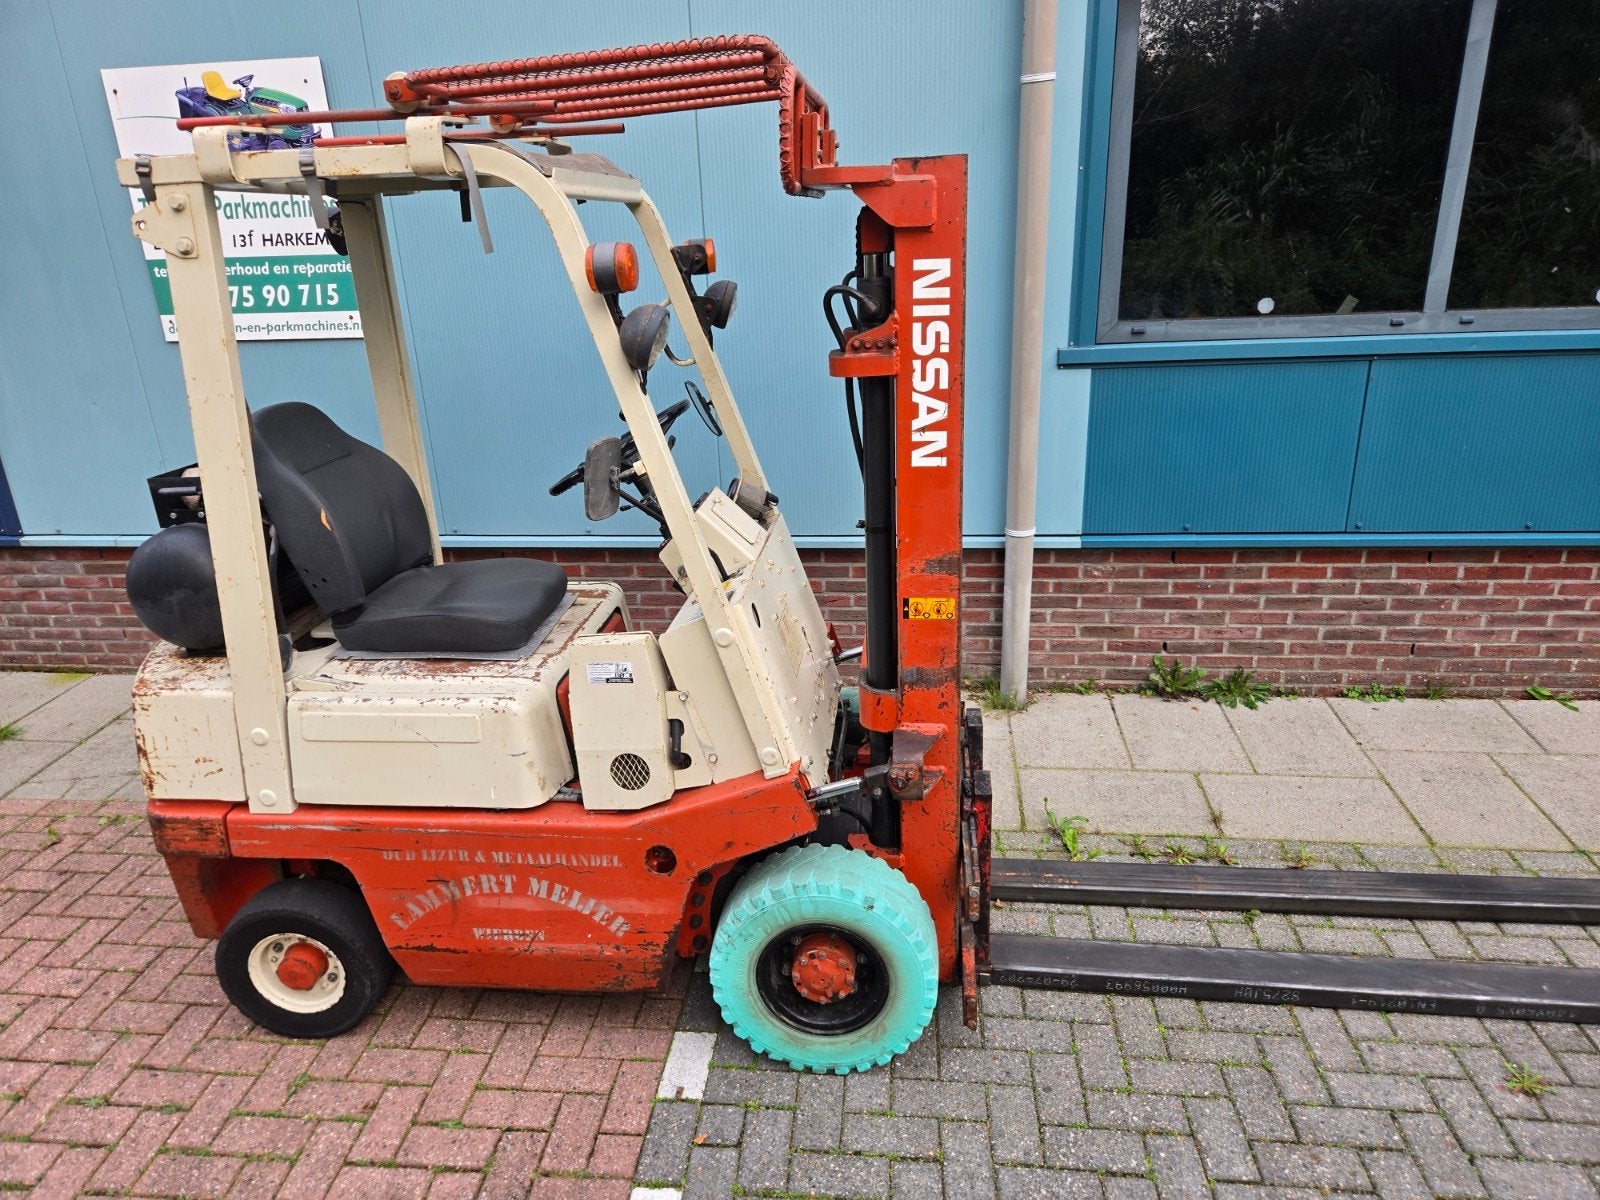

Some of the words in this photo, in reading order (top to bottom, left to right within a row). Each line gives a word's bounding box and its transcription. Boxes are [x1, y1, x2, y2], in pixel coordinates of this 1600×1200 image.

[262, 231, 331, 247] HARKEM
[225, 262, 269, 275] erhoud
[273, 264, 289, 274] en
[262, 285, 290, 307] 90
[298, 283, 339, 306] 715
[911, 258, 951, 467] NISSAN
[475, 851, 486, 862] &
[491, 852, 622, 867] METAALHANDEL
[390, 874, 516, 930] LAMMERT
